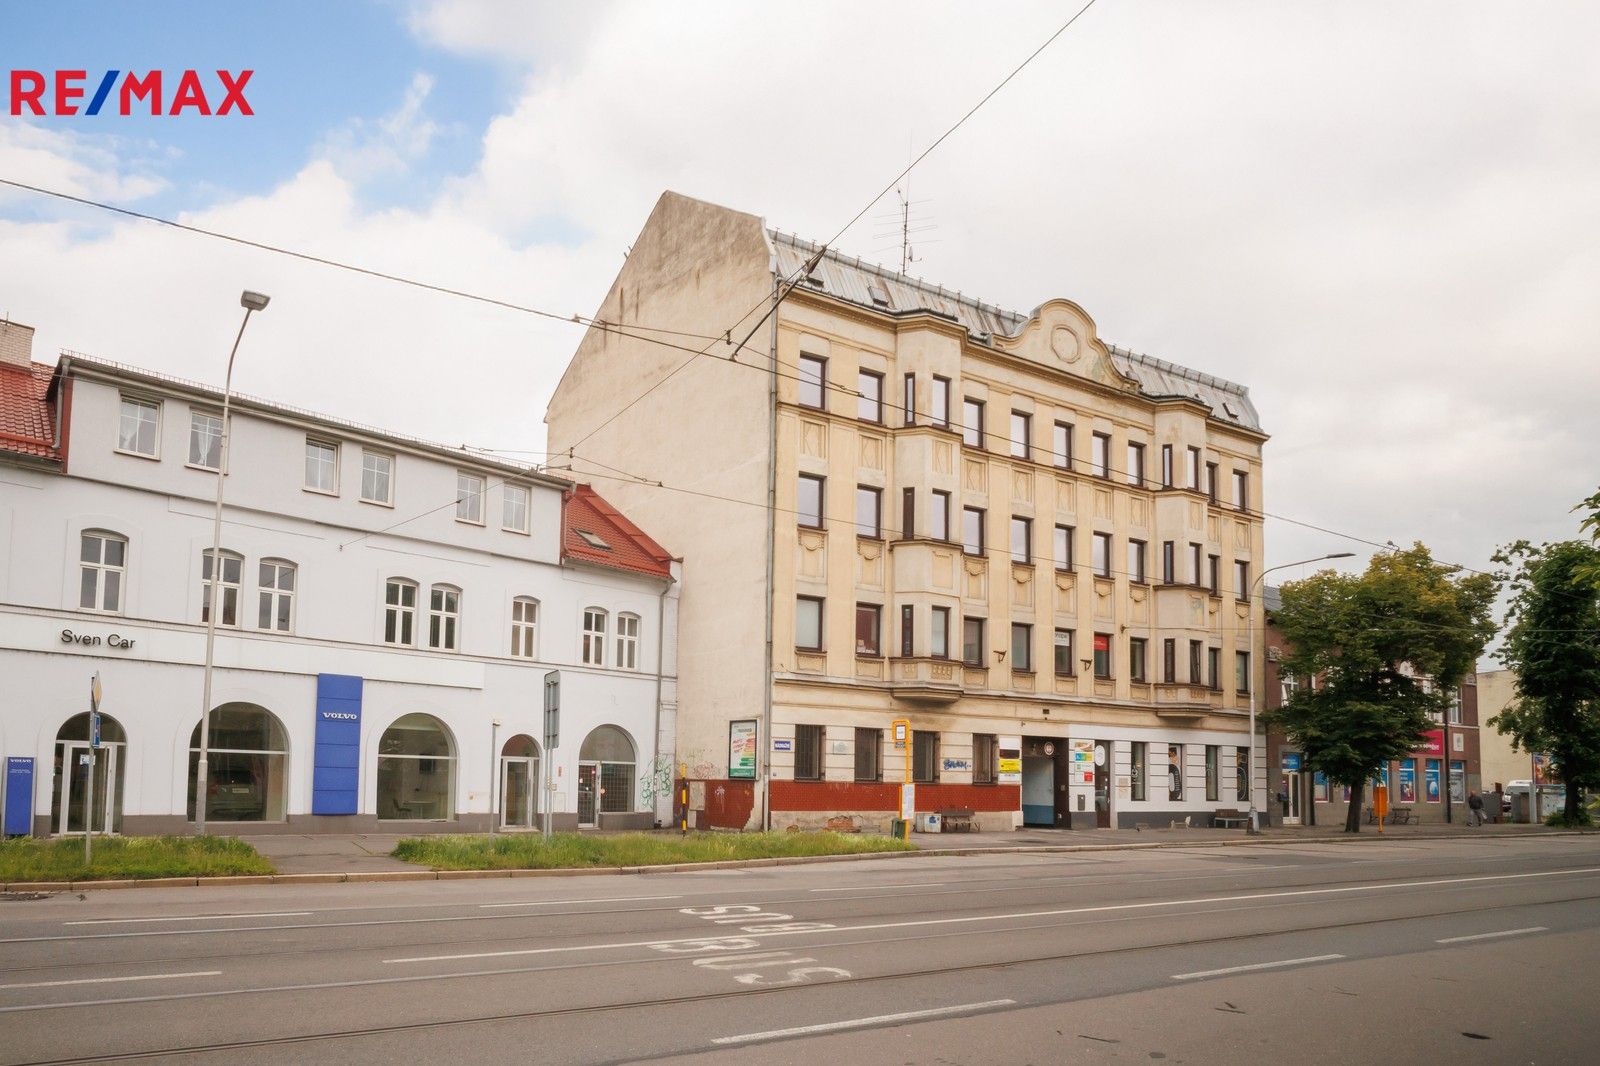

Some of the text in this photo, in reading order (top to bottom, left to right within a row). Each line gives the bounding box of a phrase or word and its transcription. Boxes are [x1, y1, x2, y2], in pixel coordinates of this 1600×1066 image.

[61, 629, 136, 649] Sven Car
[323, 712, 357, 720] VOLVO
